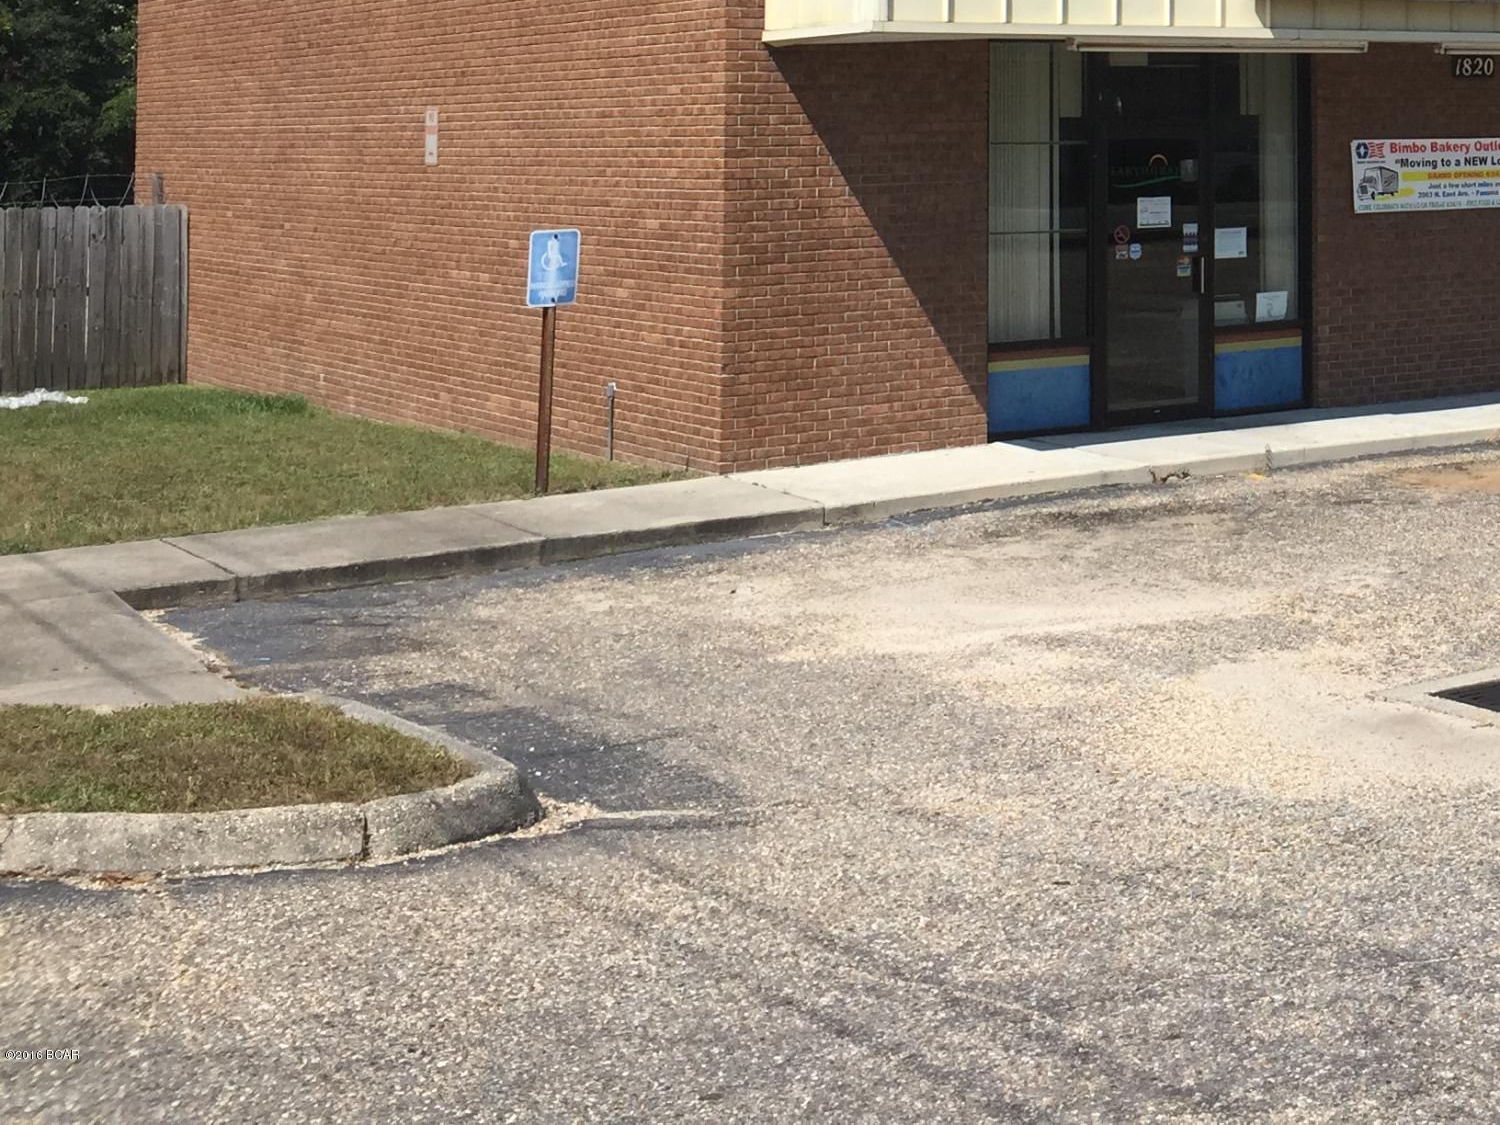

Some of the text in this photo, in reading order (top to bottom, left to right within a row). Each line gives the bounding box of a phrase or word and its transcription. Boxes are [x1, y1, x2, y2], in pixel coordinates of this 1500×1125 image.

[1456, 57, 1494, 76] 1820
[1389, 142, 1427, 154] Bimbo
[1430, 141, 1470, 155] Bakery
[1441, 157, 1452, 167] to
[1454, 159, 1461, 167] a
[1464, 156, 1488, 166] NEW
